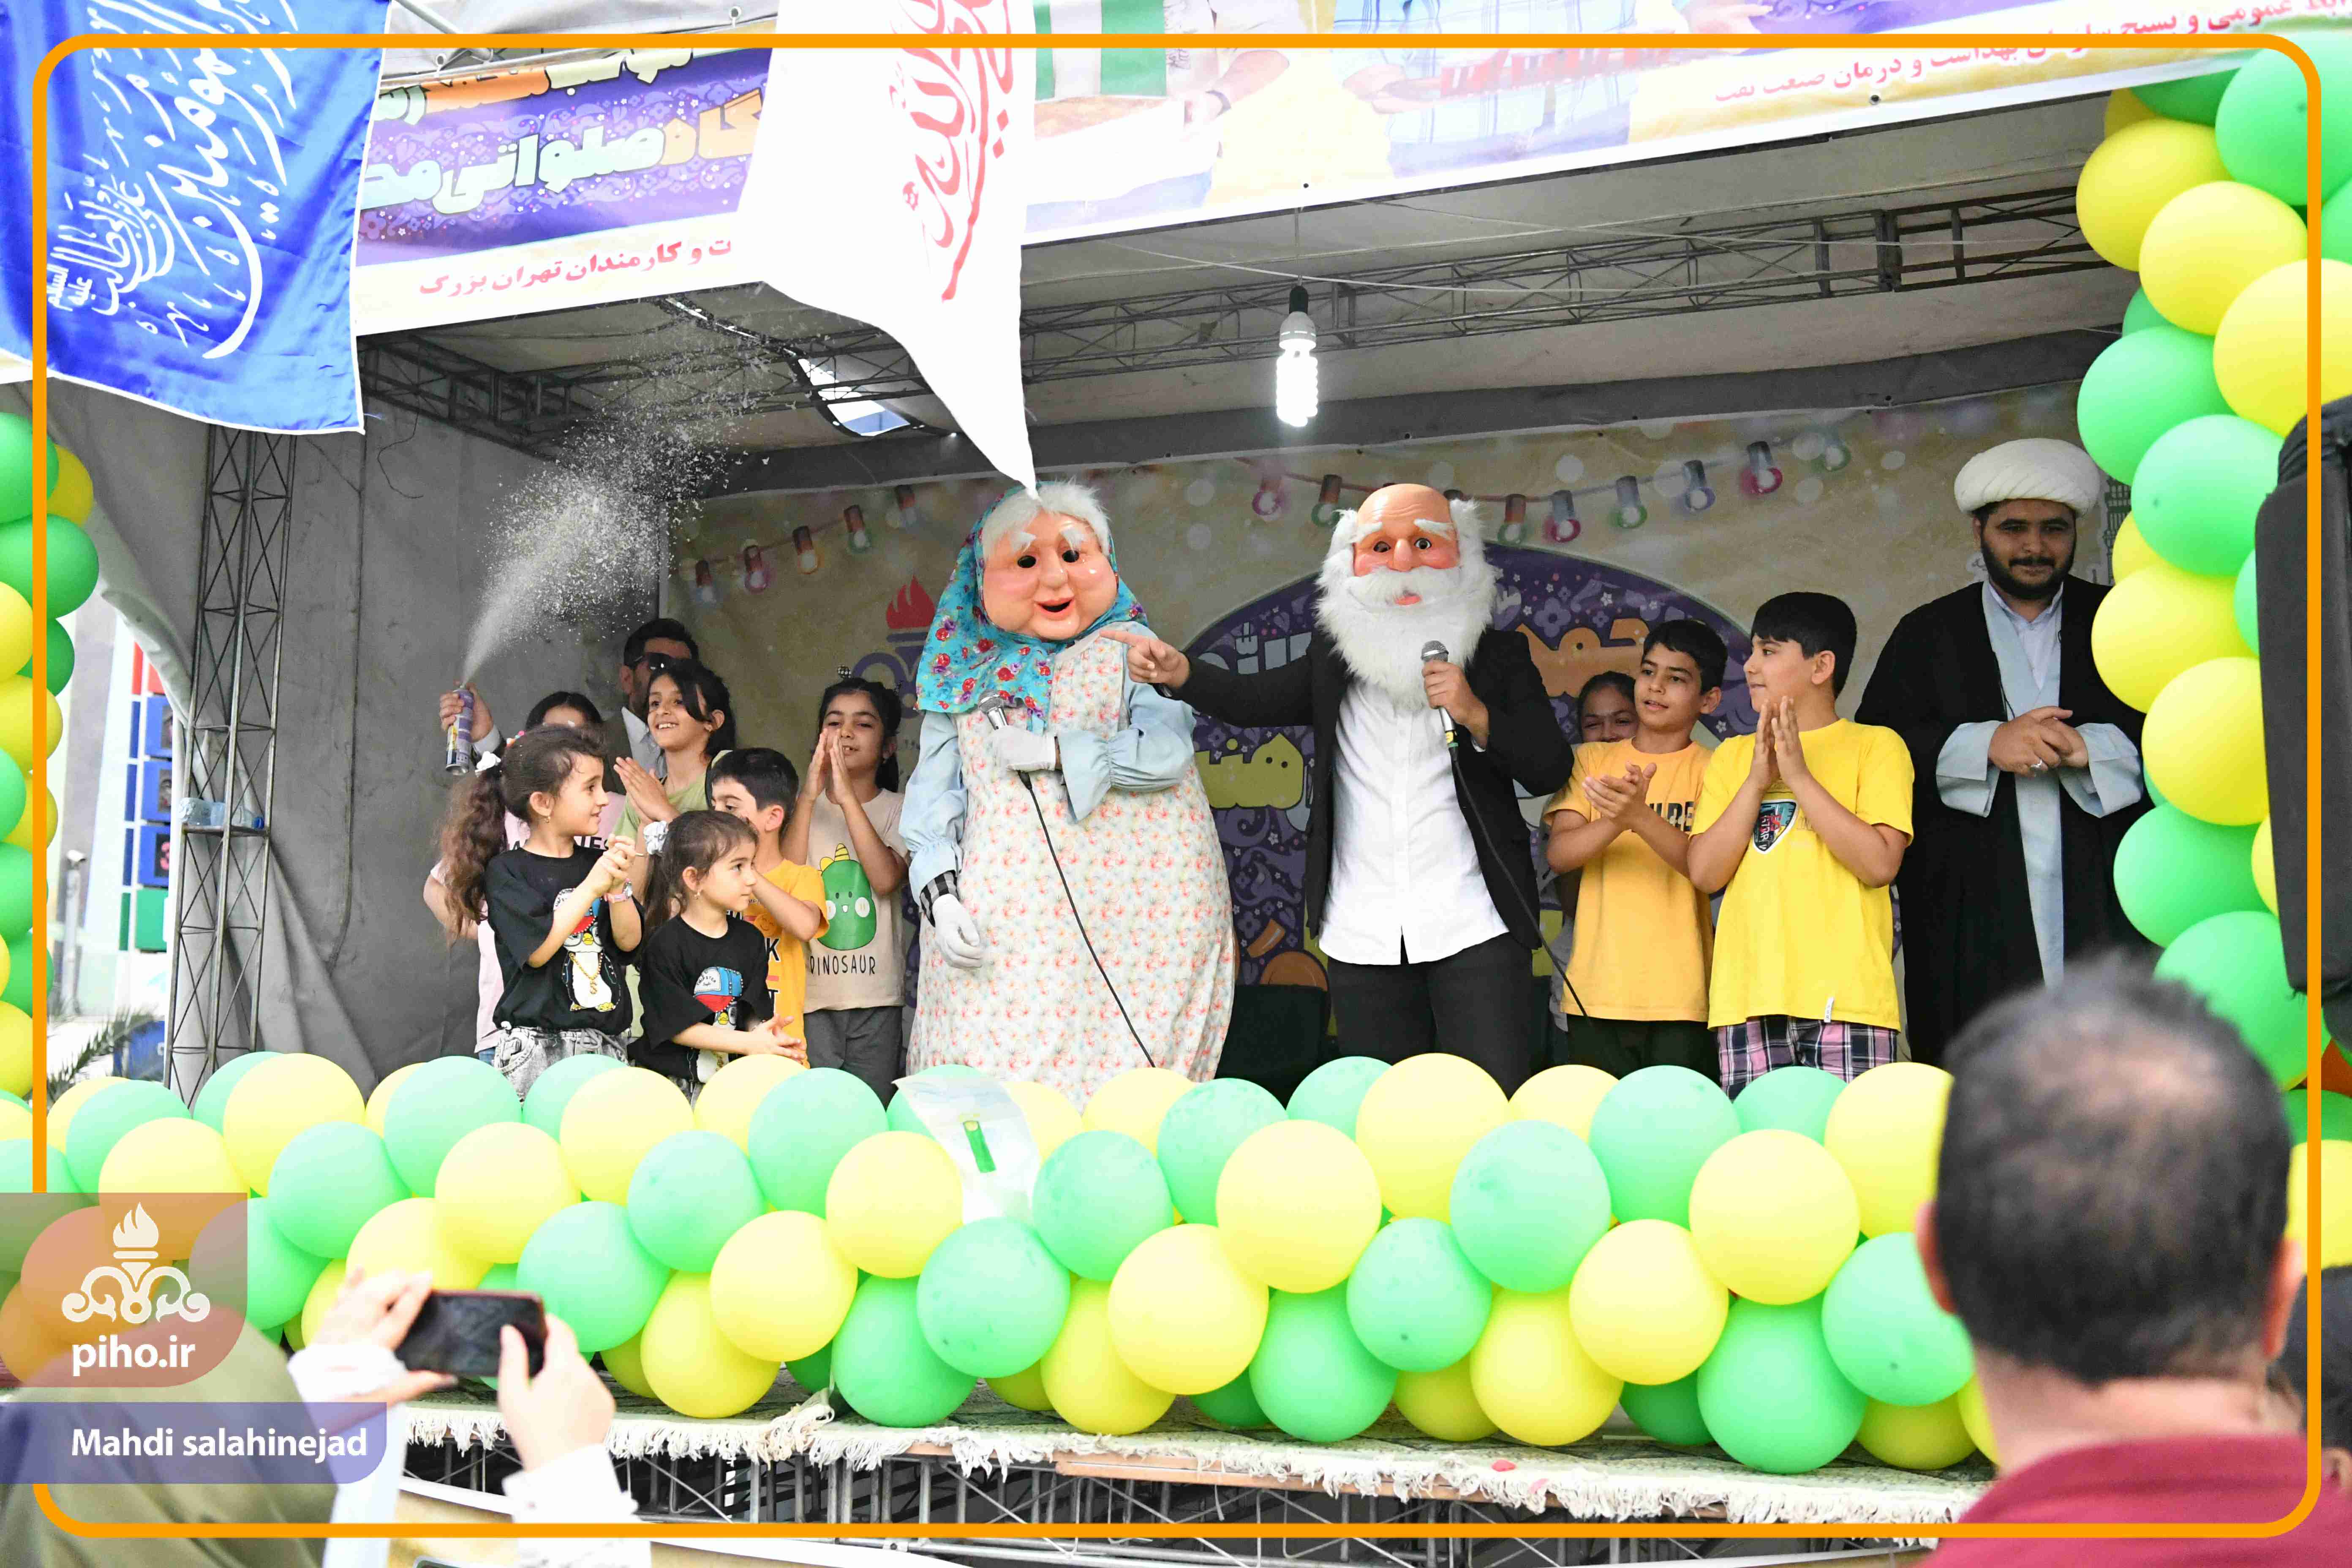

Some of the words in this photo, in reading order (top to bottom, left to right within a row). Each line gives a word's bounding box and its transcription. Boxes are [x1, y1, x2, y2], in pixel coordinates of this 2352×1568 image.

[2188, 15, 2198, 34] و
[1834, 58, 1901, 88] درمان
[1911, 60, 1922, 77] و
[433, 124, 665, 214] صلواتی
[565, 241, 683, 282] کارمندان
[689, 247, 702, 264] و
[491, 261, 562, 291] تهران
[810, 954, 876, 976] DINOSAUR
